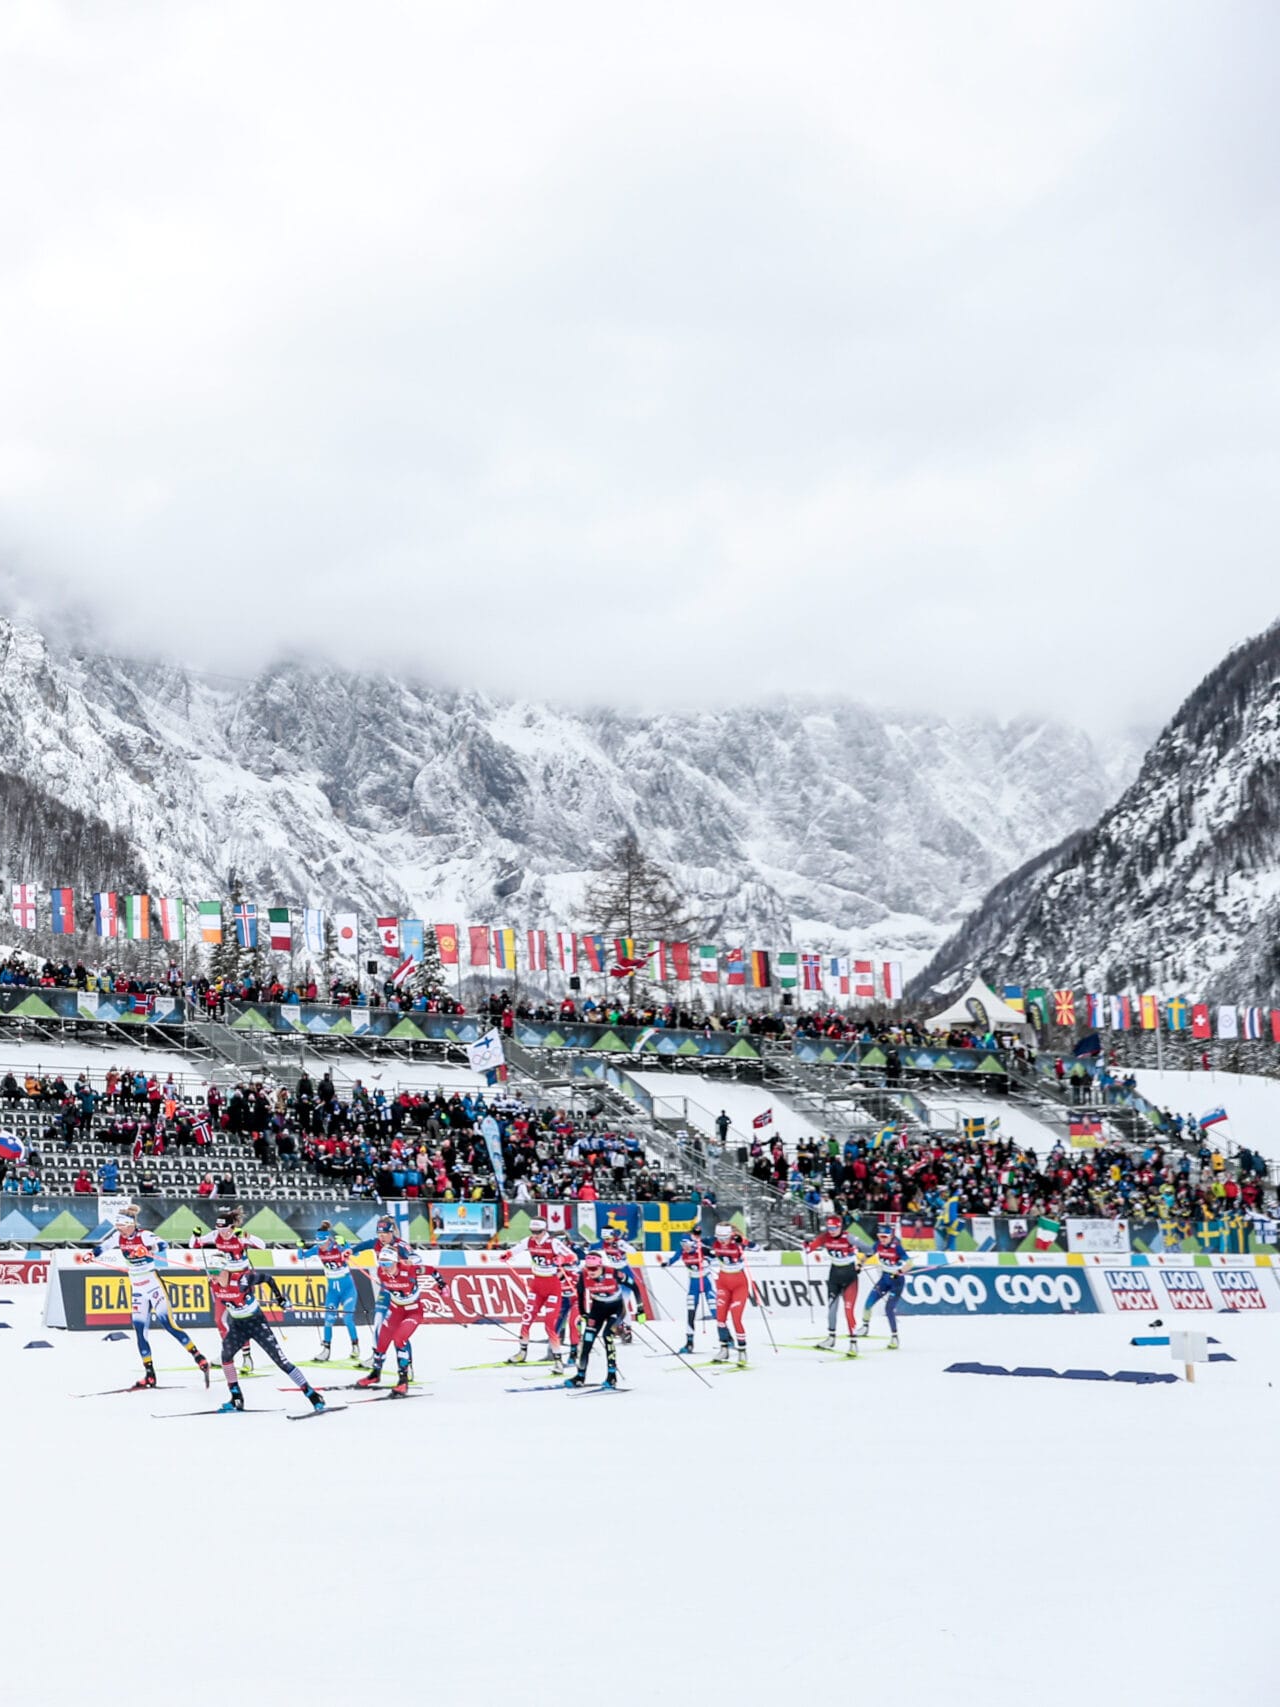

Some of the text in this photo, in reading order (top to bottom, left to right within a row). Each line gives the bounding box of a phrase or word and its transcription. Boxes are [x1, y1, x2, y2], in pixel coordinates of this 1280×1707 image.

[534, 1256, 546, 1265] 12
[1105, 1271, 1150, 1290] LIQUI
[1161, 1271, 1204, 1290] LIQUI
[1213, 1271, 1258, 1290] LIQUI
[92, 1279, 205, 1310] BLÅDER
[748, 1280, 826, 1307] WÜRT
[995, 1274, 1081, 1311] coop
[1112, 1291, 1158, 1310] MOLY
[1168, 1291, 1213, 1309] MOLY
[1221, 1291, 1266, 1309] MOLY
